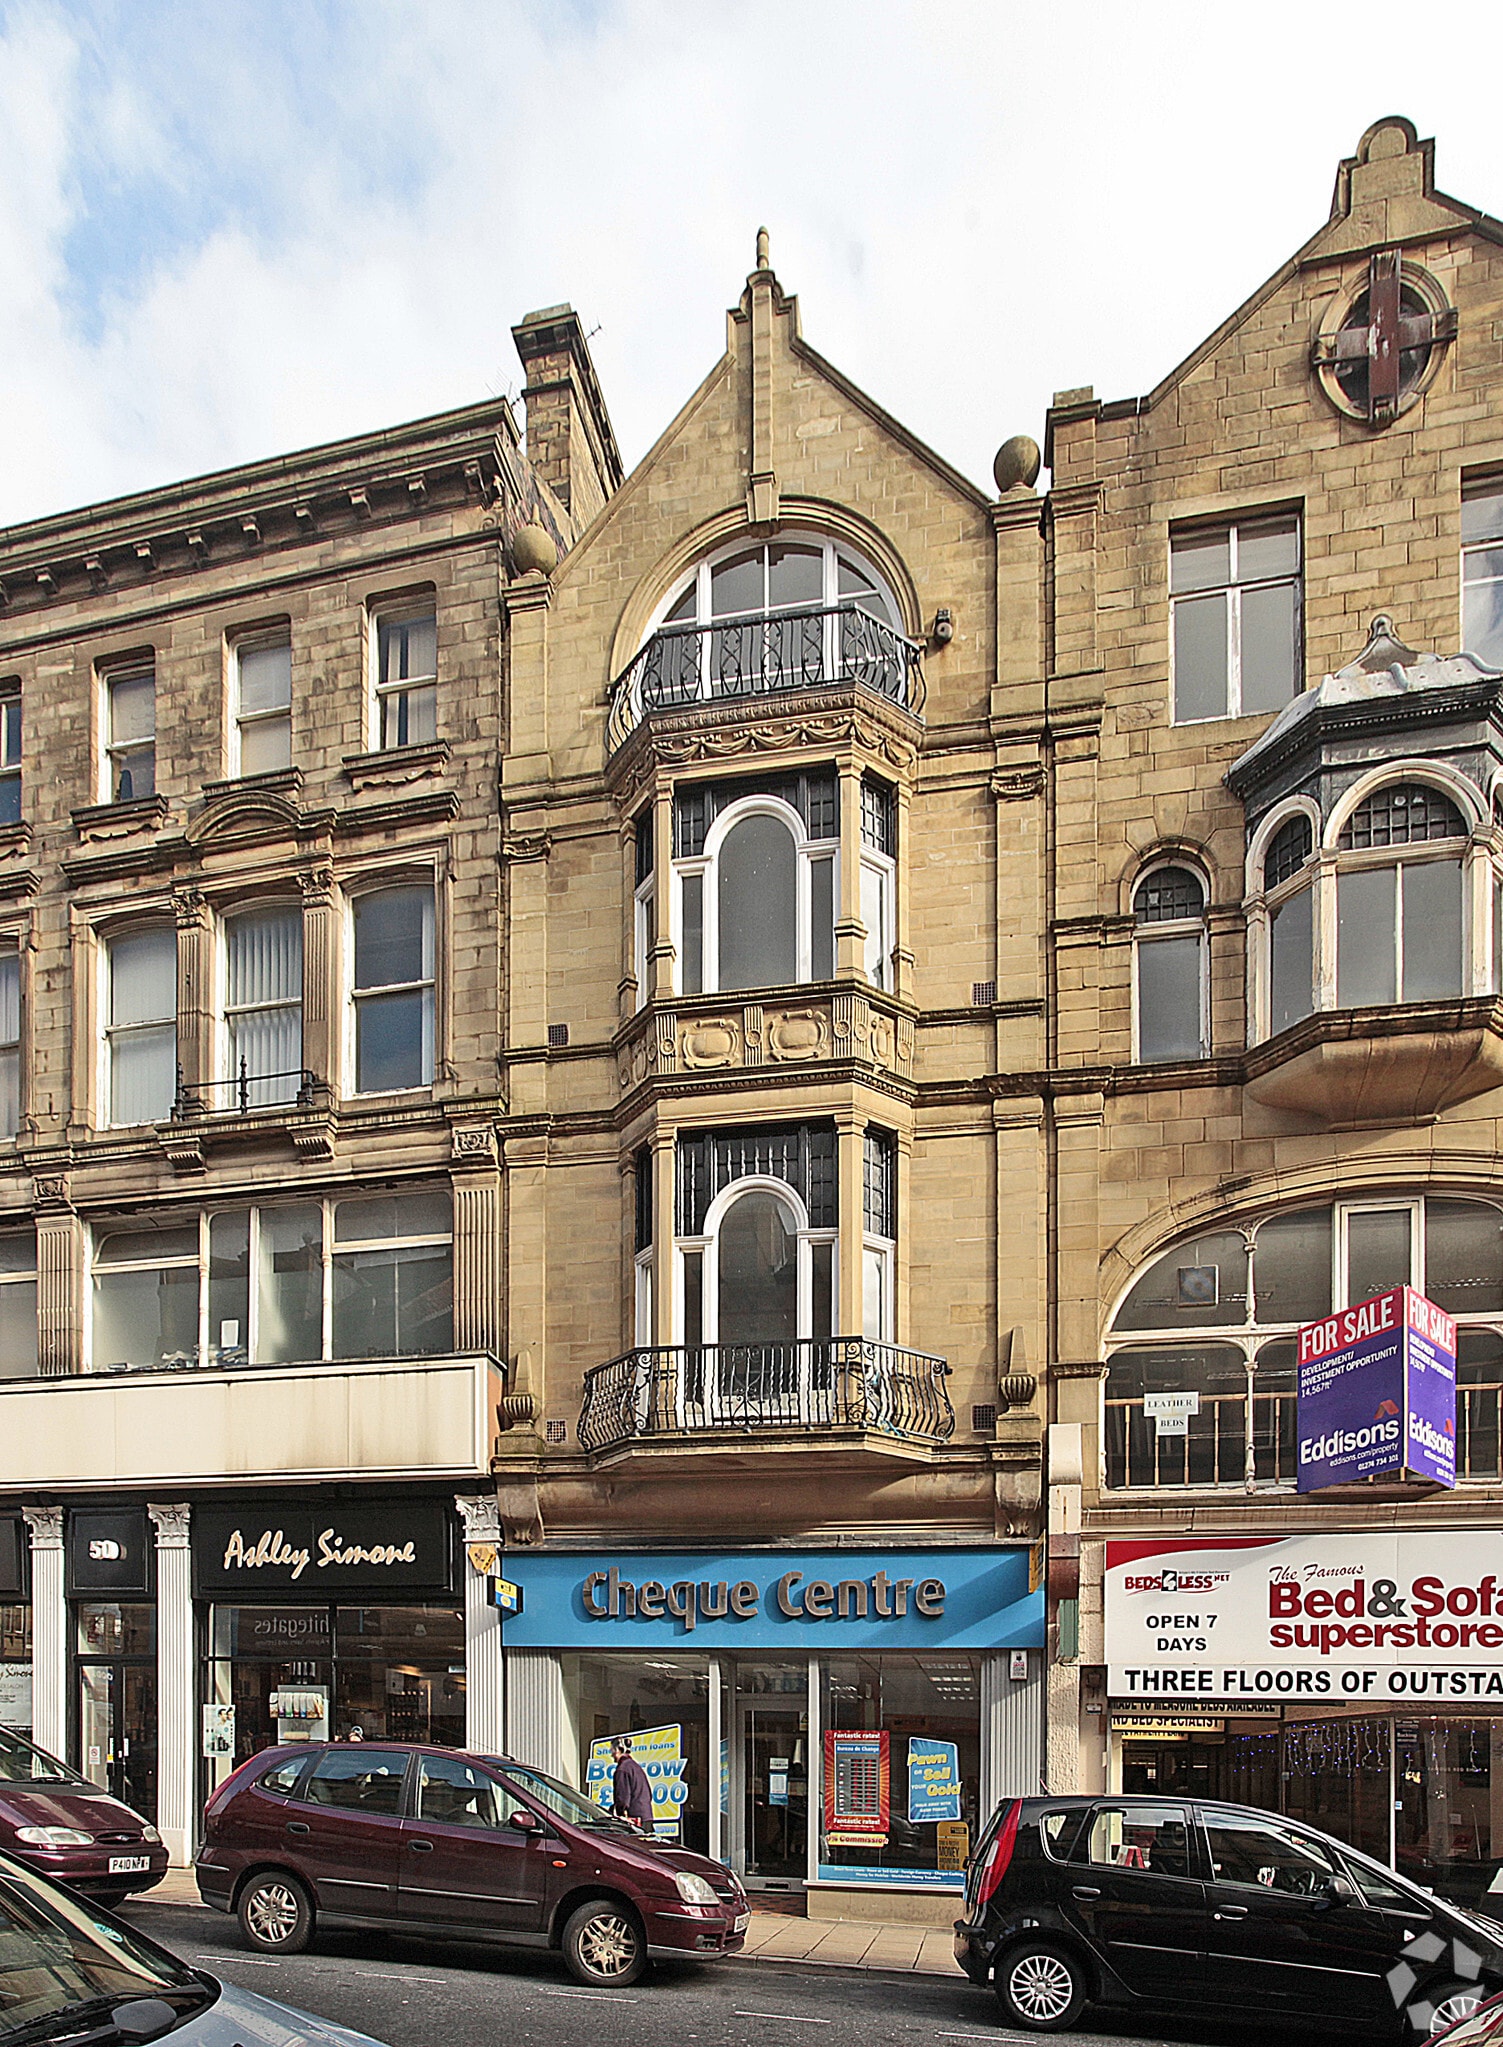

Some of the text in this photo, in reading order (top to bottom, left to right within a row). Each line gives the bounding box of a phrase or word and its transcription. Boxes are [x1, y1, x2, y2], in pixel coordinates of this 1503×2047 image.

[1301, 1295, 1394, 1360] FOR SALE
[1410, 1292, 1429, 1335] FOR
[1430, 1308, 1453, 1351] SALE
[1301, 1351, 1354, 1377] DEVELOPMENT/
[1301, 1364, 1345, 1387] INVESTMENT
[1346, 1345, 1398, 1371] OPPORTUNITY
[1147, 1399, 1193, 1408] LEATHER
[1160, 1419, 1185, 1427] BEDS
[1300, 1419, 1399, 1465] Eddisons
[1409, 1412, 1455, 1460] Eddisons
[1329, 1442, 1398, 1467] eddisons.com/property
[89, 1539, 121, 1560] 50
[224, 1528, 416, 1579] Ashley Simone
[1269, 1564, 1365, 1582] The Famous
[582, 1566, 946, 1630] Cheque Centre
[1146, 1615, 1218, 1628] OPEN 7
[1157, 1638, 1207, 1651] DAYS
[1270, 1617, 1503, 1655] superstore
[1124, 1670, 1503, 1695] THREE FLOORS OF OUTSTA
[1112, 1717, 1128, 1726] ND
[649, 1743, 676, 1752] loans
[907, 1753, 948, 1766] Pawn
[587, 1760, 687, 1782] Boow
[922, 1766, 952, 1780] Sell
[600, 1780, 688, 1808] £00
[926, 1781, 963, 1796] Gold
[839, 1835, 889, 1844] Commission
